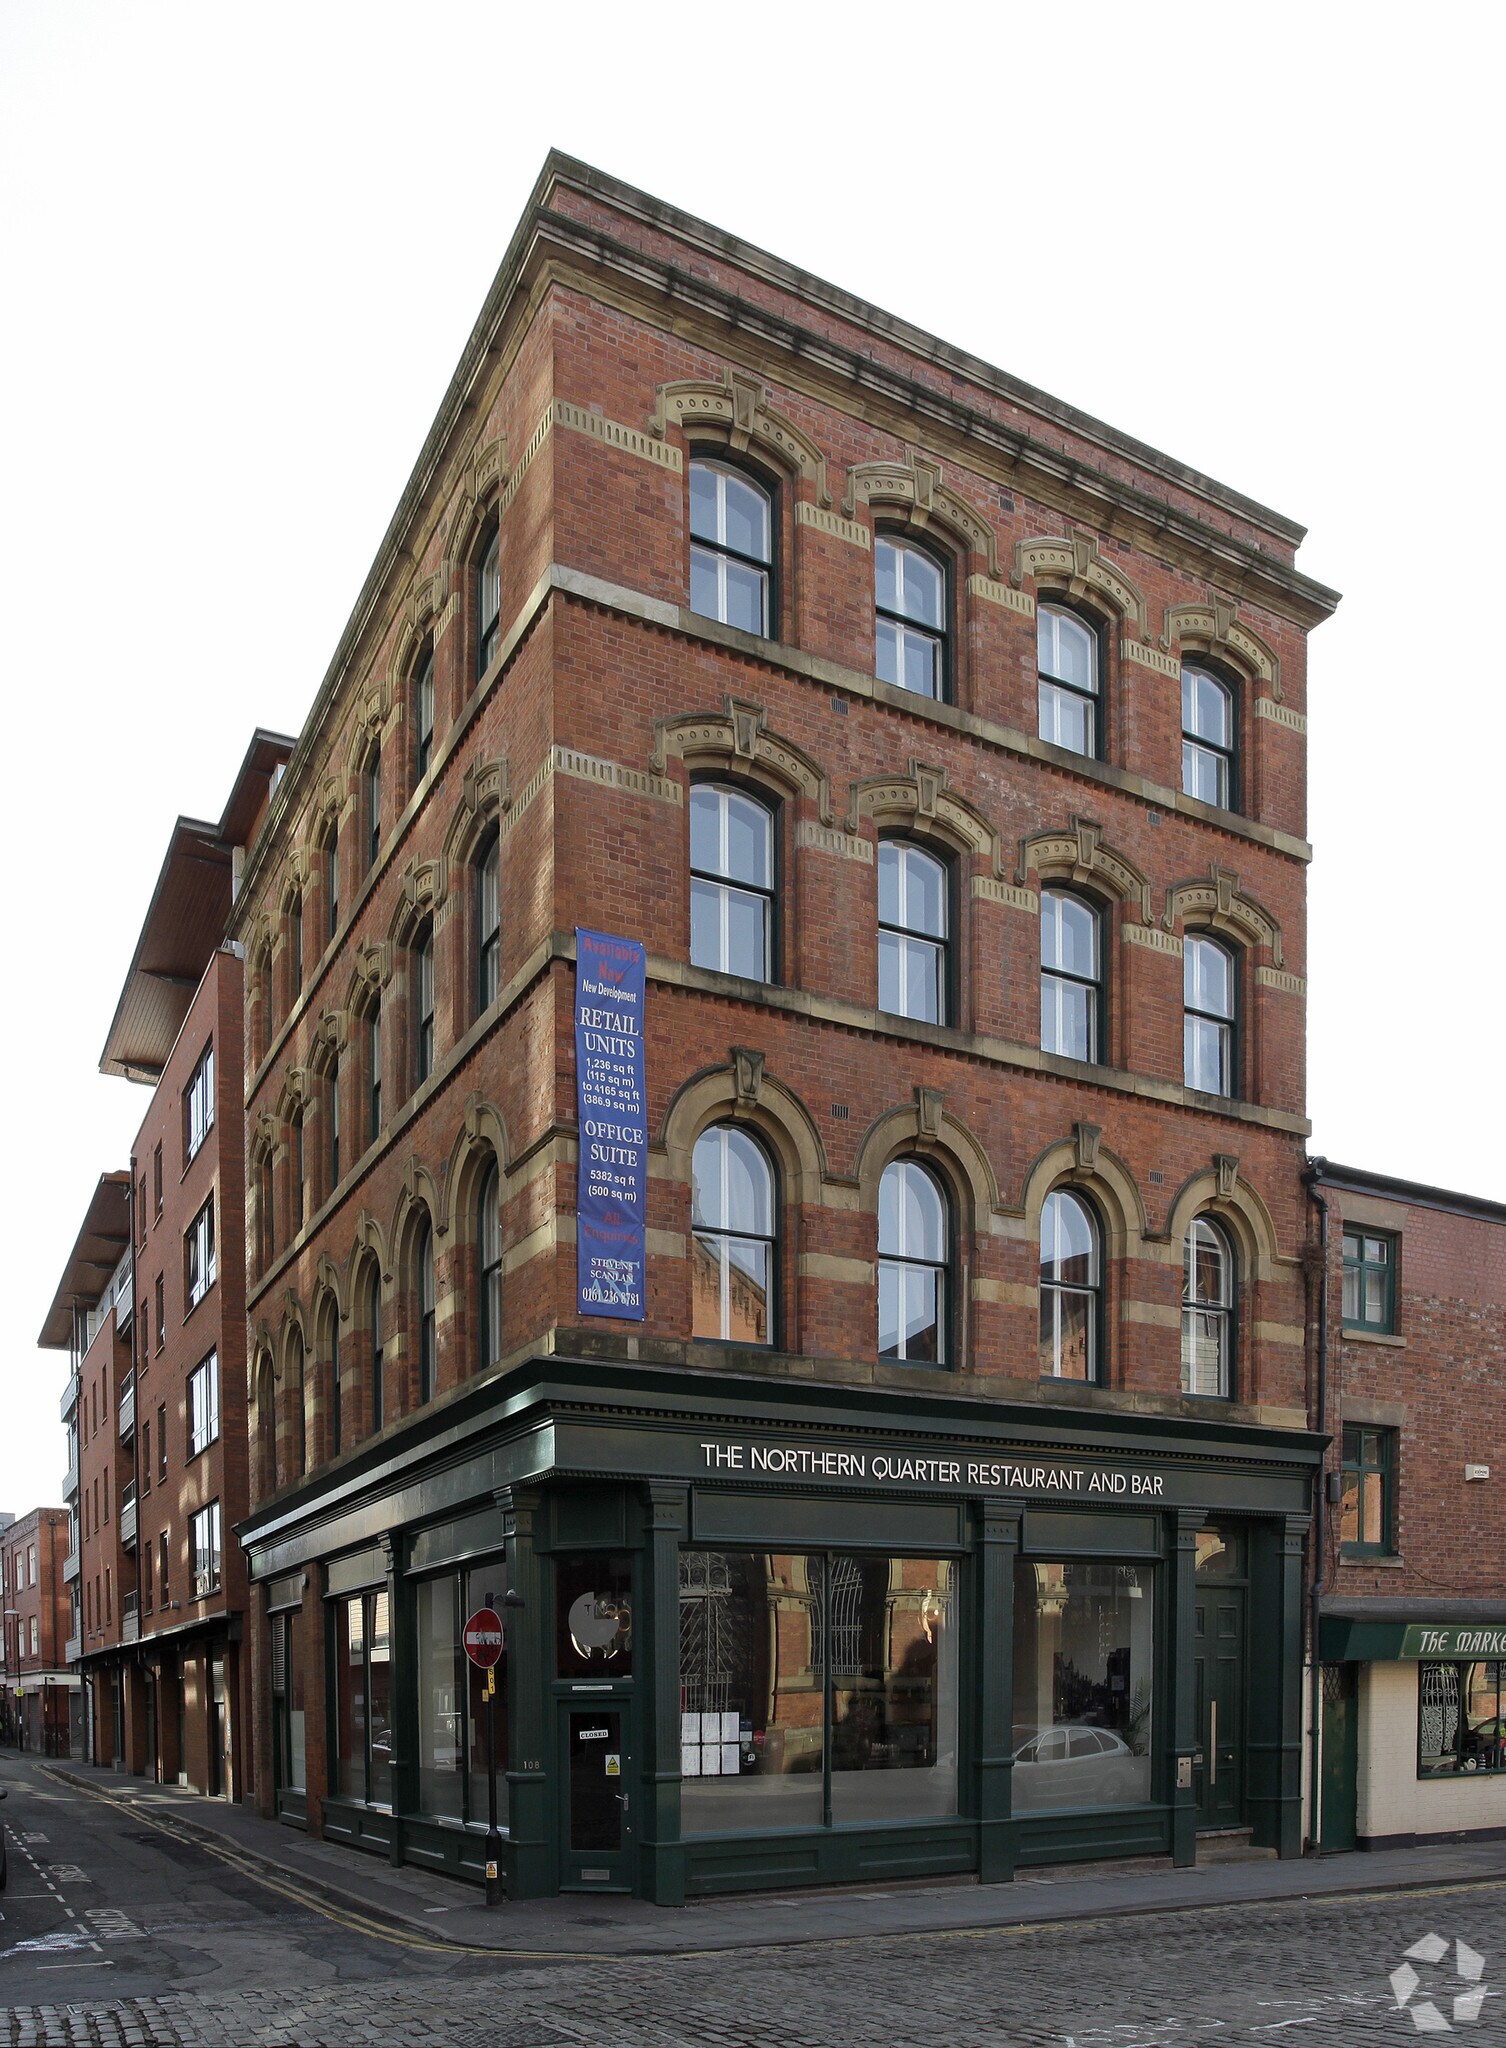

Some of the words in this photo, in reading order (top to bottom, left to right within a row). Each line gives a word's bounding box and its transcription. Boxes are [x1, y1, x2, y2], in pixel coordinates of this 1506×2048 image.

[583, 936, 639, 963] Available
[599, 961, 624, 984] Now
[582, 979, 597, 994] New
[598, 982, 637, 1003] Development
[580, 1007, 639, 1036] RETAIL
[584, 1032, 636, 1058] UNITS
[586, 1058, 611, 1071] 1,236
[613, 1064, 626, 1075] sq
[627, 1064, 635, 1075] ft
[587, 1070, 606, 1082] (115
[608, 1075, 620, 1086] sq
[622, 1076, 635, 1089] m)
[583, 1081, 592, 1091] to
[594, 1083, 617, 1096] 4165
[618, 1089, 630, 1101] sq
[632, 1090, 640, 1101] ft
[584, 1094, 611, 1107] (386.9
[613, 1101, 626, 1113] sq
[627, 1102, 640, 1114] m)
[584, 1120, 644, 1145] OFFICE
[590, 1144, 638, 1167] SUITE
[590, 1169, 612, 1183] 5382
[614, 1174, 627, 1186] sq
[628, 1174, 636, 1186] ft
[588, 1185, 609, 1198] (500
[611, 1189, 623, 1201] sq
[625, 1191, 637, 1203] m)
[590, 1257, 634, 1271] STEVENS
[590, 1269, 635, 1283] SCANLAN
[582, 1287, 601, 1302] 0161
[603, 1289, 619, 1304] 236
[620, 1291, 640, 1306] 8781
[700, 1443, 744, 1470] THE
[750, 1446, 866, 1477] NORTHERN
[871, 1456, 962, 1484] QUARTER
[967, 1463, 1085, 1492] RESTAURANT
[1088, 1471, 1127, 1495] AND
[1131, 1474, 1164, 1496] BAR
[1420, 1631, 1450, 1653] THE
[581, 1731, 607, 1739] CLOSED
[523, 1760, 540, 1770] 108
